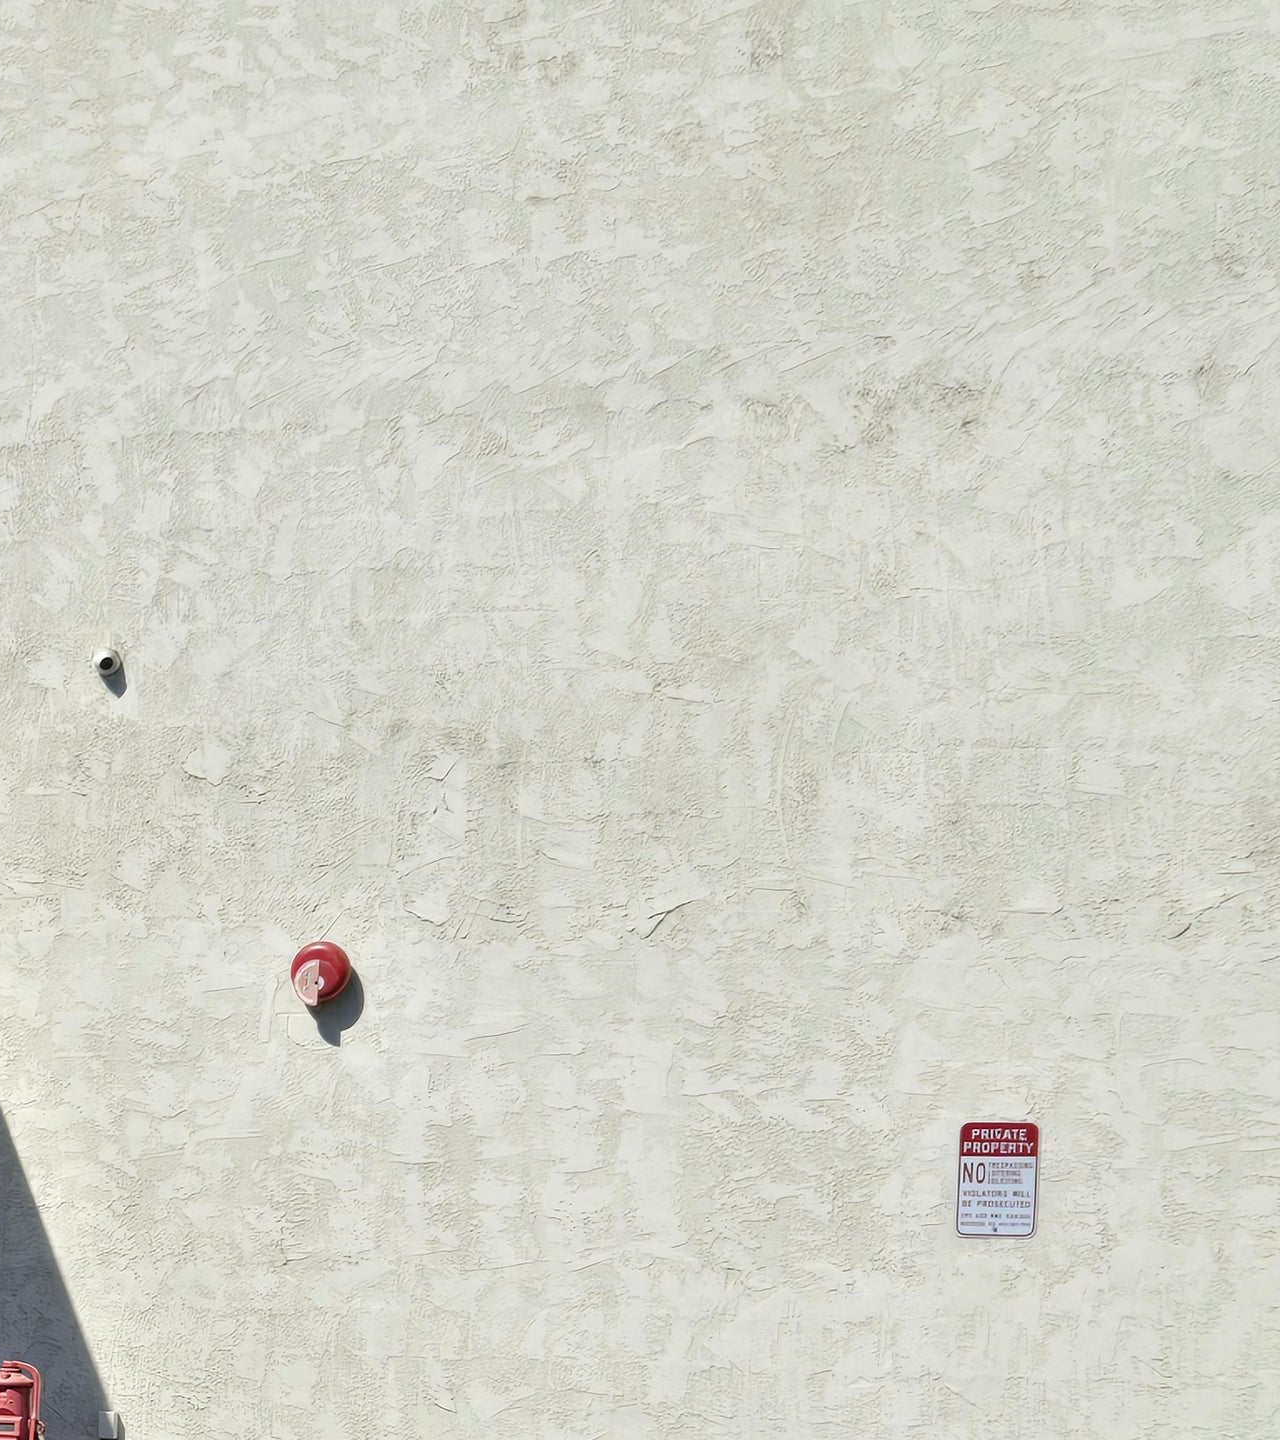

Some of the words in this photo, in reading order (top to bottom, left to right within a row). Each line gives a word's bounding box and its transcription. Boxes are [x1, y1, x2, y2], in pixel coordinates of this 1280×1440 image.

[971, 1128, 1027, 1140] PRIVATE
[963, 1141, 1034, 1153] PROPERTY
[962, 1162, 986, 1184] NO
